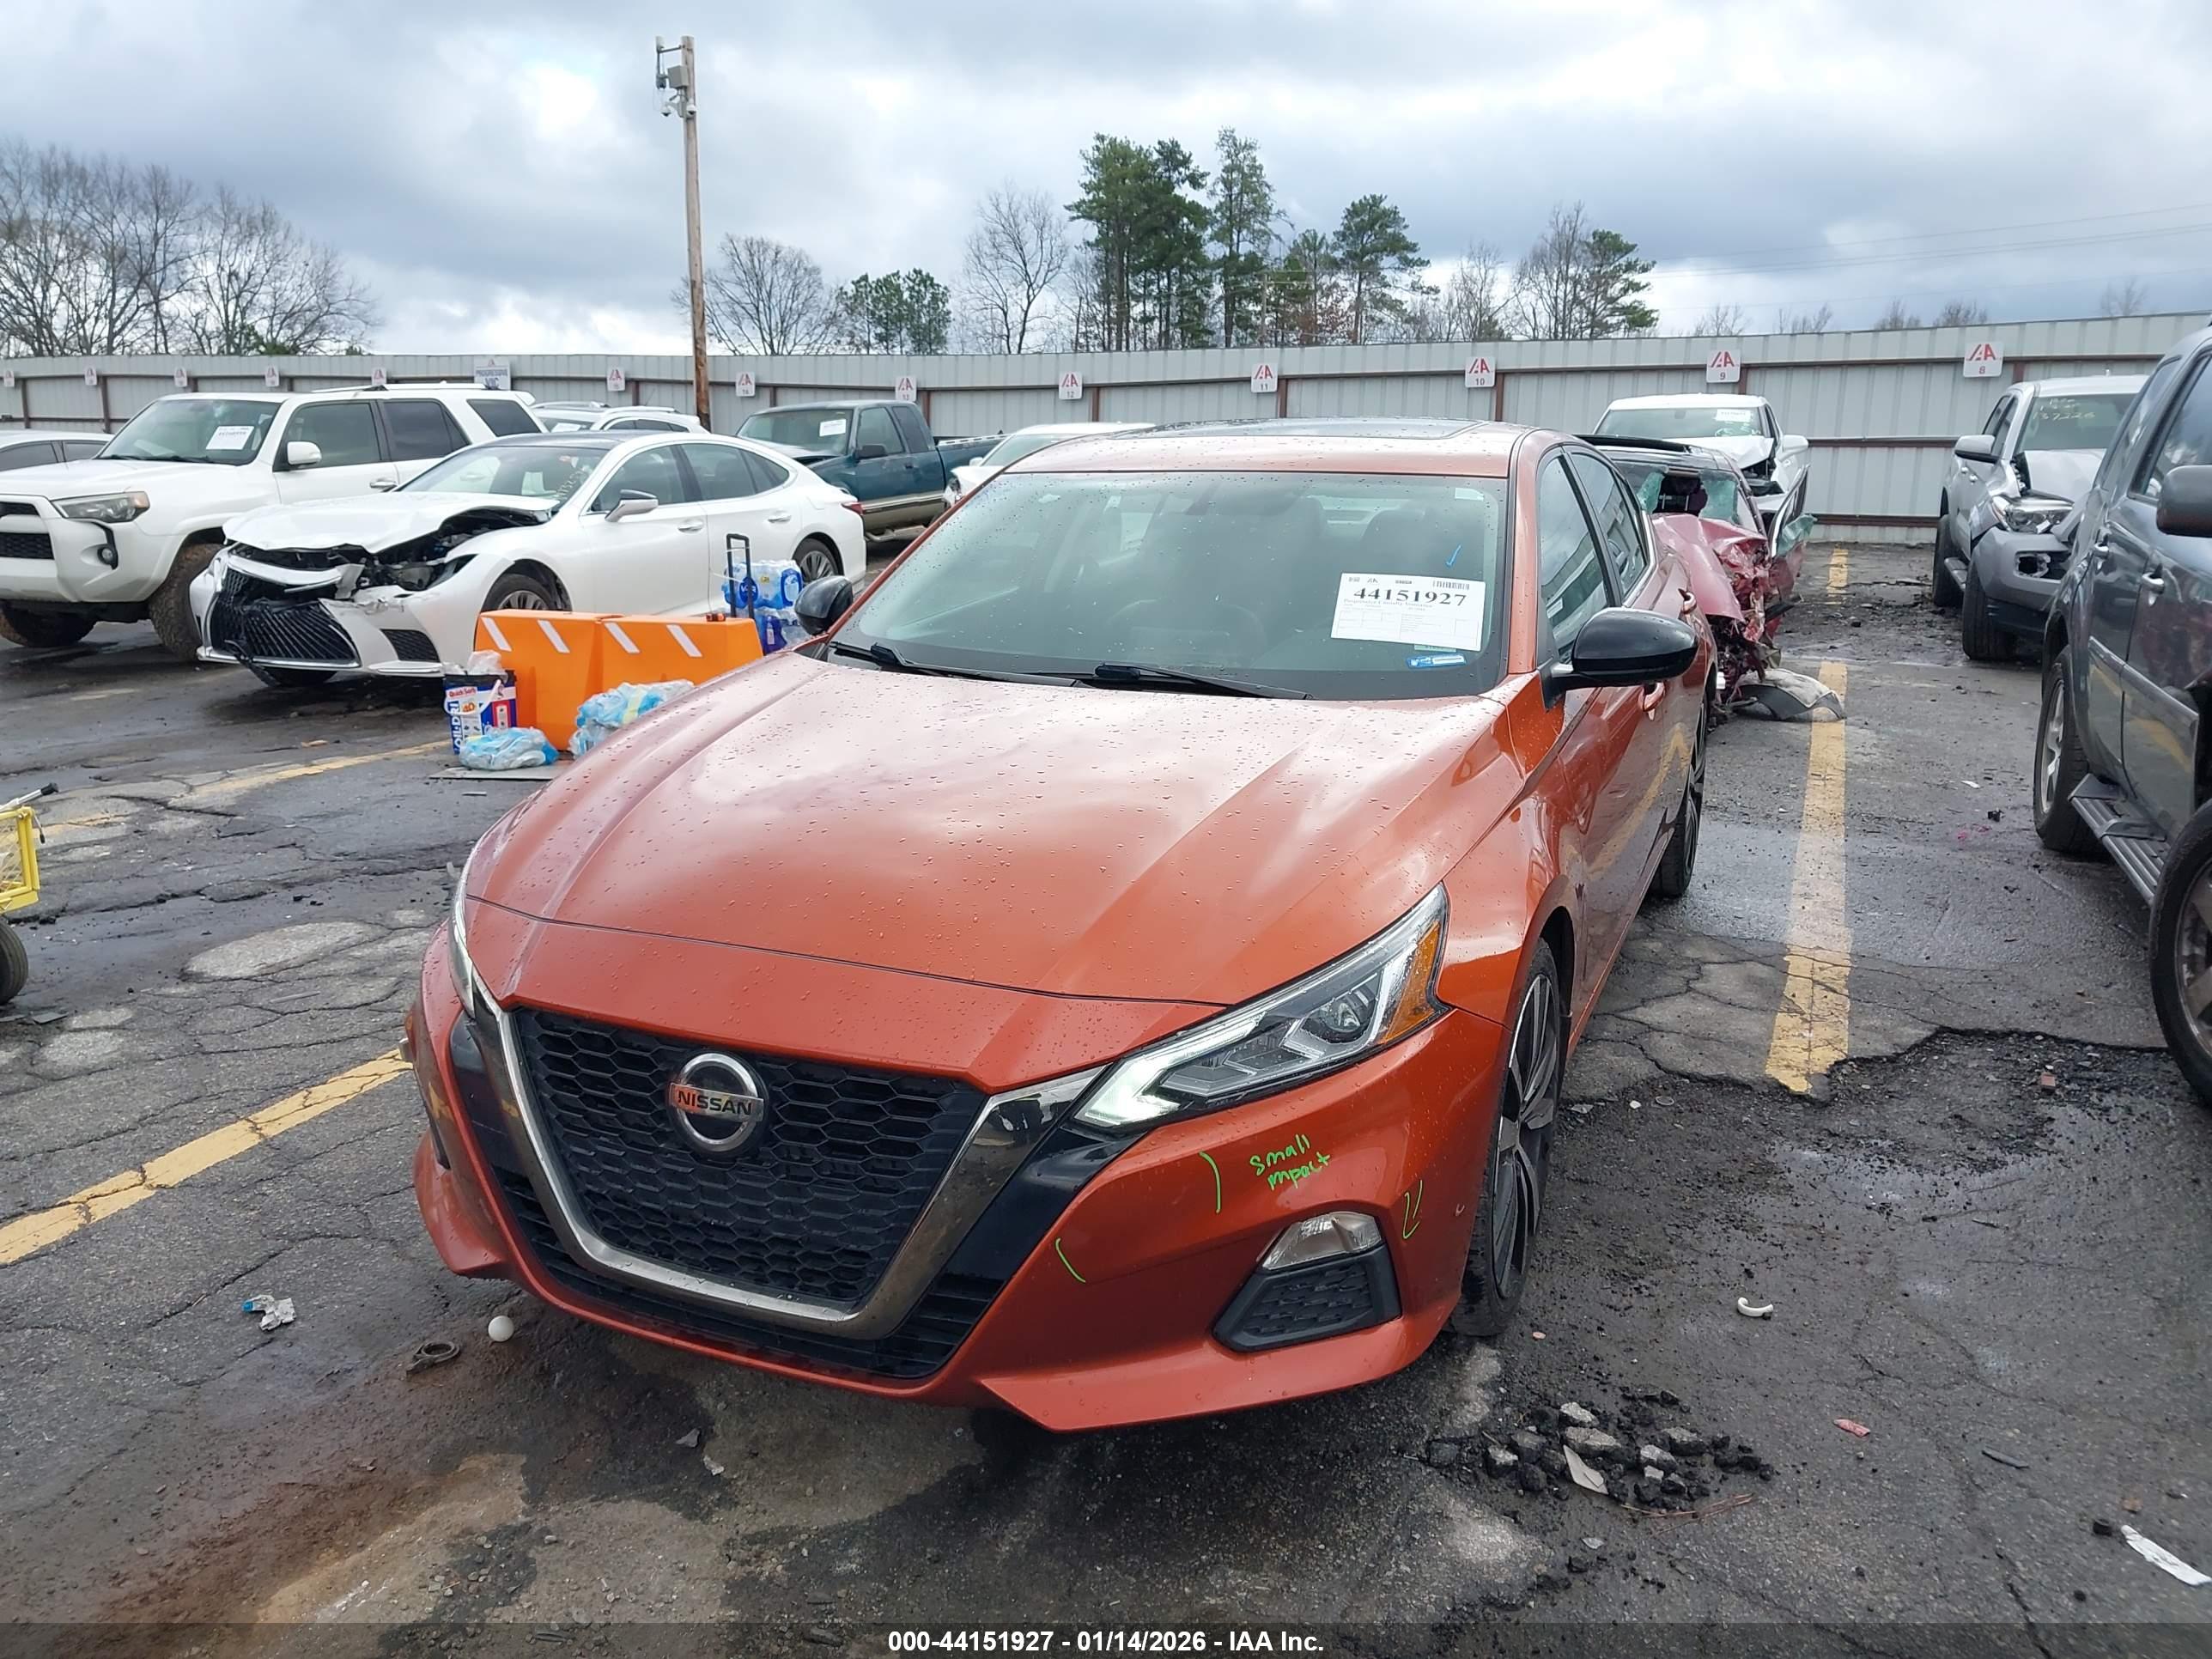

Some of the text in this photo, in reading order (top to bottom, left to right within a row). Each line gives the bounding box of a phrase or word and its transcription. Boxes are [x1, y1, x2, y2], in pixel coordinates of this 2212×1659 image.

[1720, 372, 1726, 380] 9
[1353, 587, 1467, 606] 44151927
[678, 1091, 752, 1115] NISSAN
